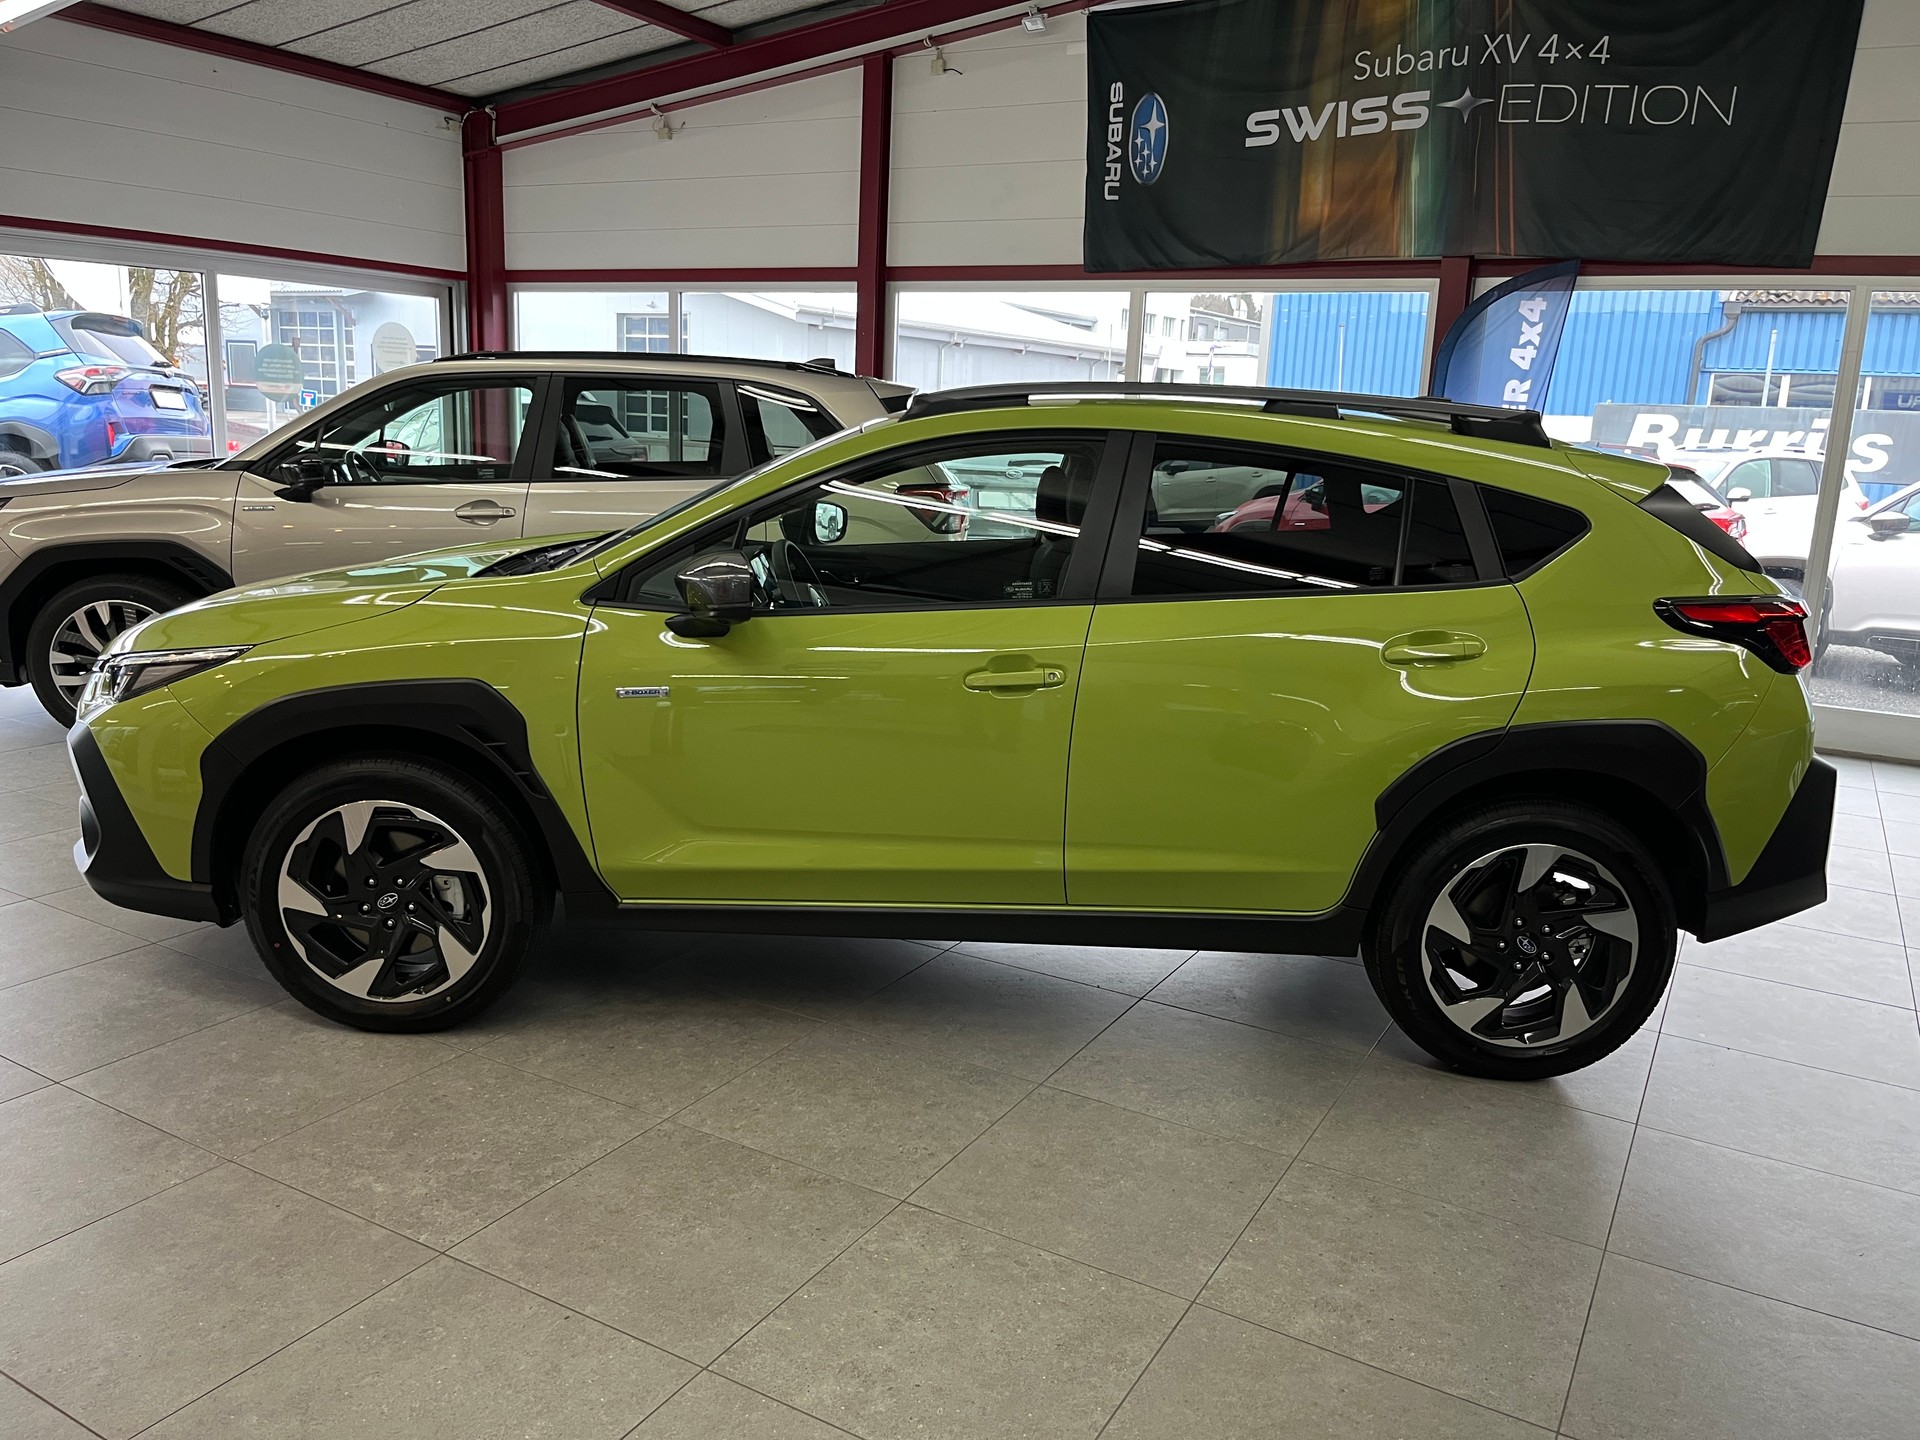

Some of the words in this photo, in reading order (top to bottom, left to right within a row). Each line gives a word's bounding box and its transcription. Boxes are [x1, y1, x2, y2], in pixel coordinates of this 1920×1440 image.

[1353, 44, 1469, 81] Subaru
[1480, 33, 1531, 64] XV
[1104, 81, 1124, 201] SUBARU
[1245, 90, 1431, 148] SWISS
[1498, 84, 1738, 126] EDITION
[1510, 297, 1547, 371] 4x4
